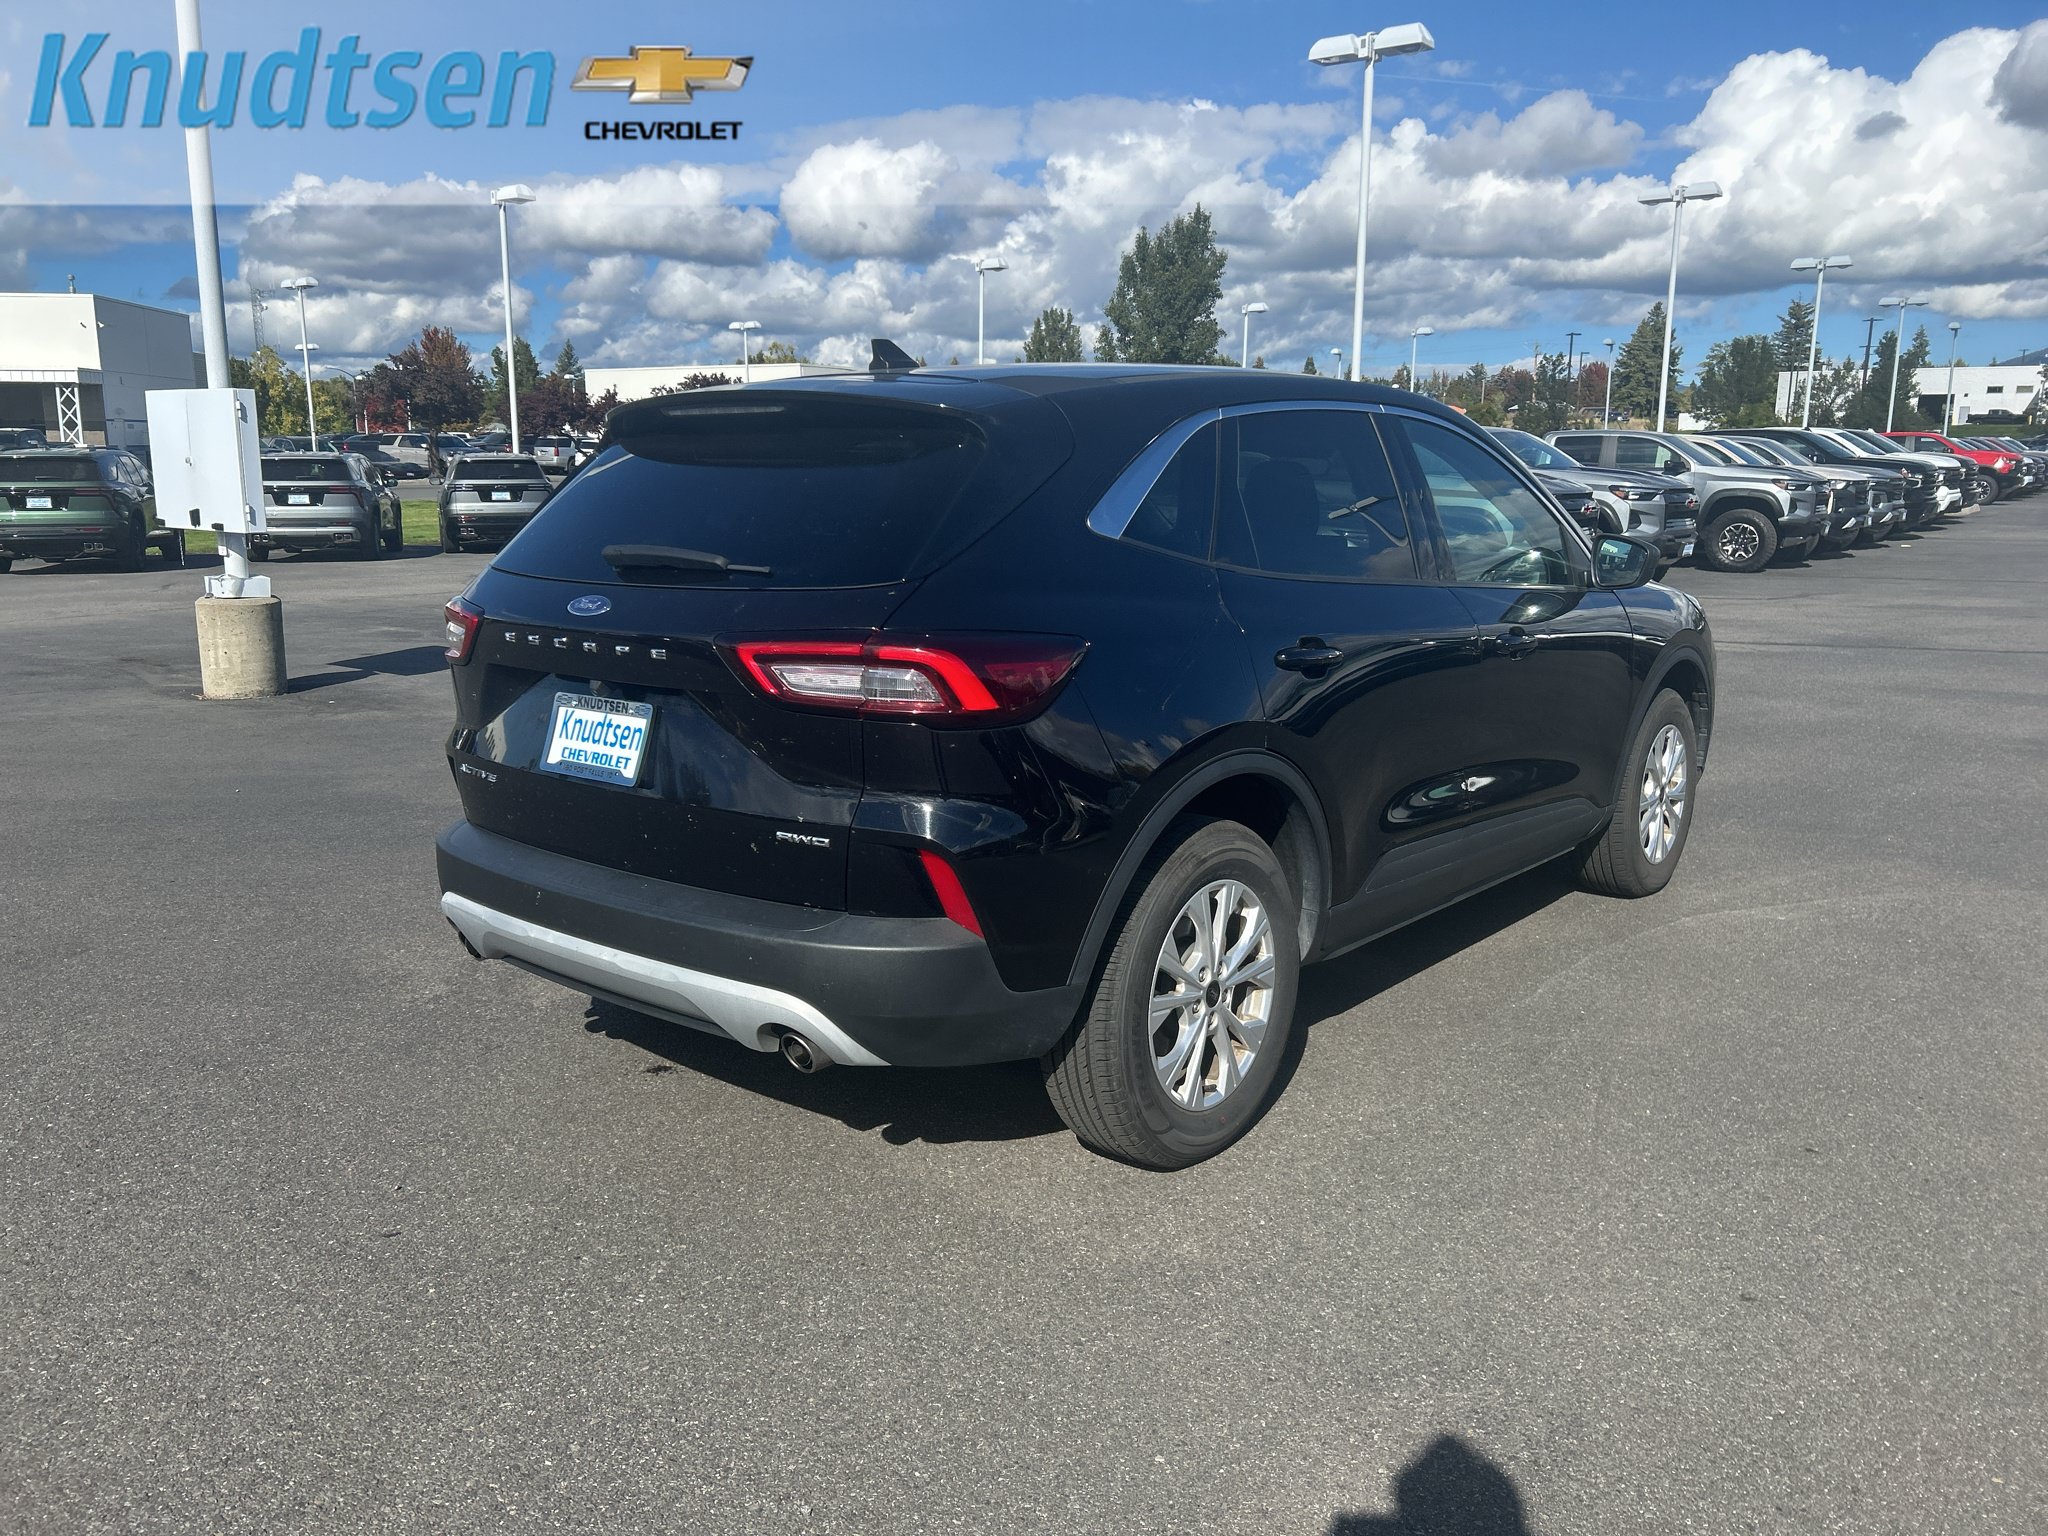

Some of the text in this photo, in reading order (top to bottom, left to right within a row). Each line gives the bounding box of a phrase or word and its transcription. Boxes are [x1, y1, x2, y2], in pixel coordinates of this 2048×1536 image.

[505, 632, 666, 660] ESCAPE
[577, 696, 629, 714] KNUDTSEN
[559, 709, 643, 751] Knudtsen
[561, 747, 631, 769] CHEVROLET
[460, 763, 497, 782] ACTIVE
[776, 831, 830, 847] AWD
